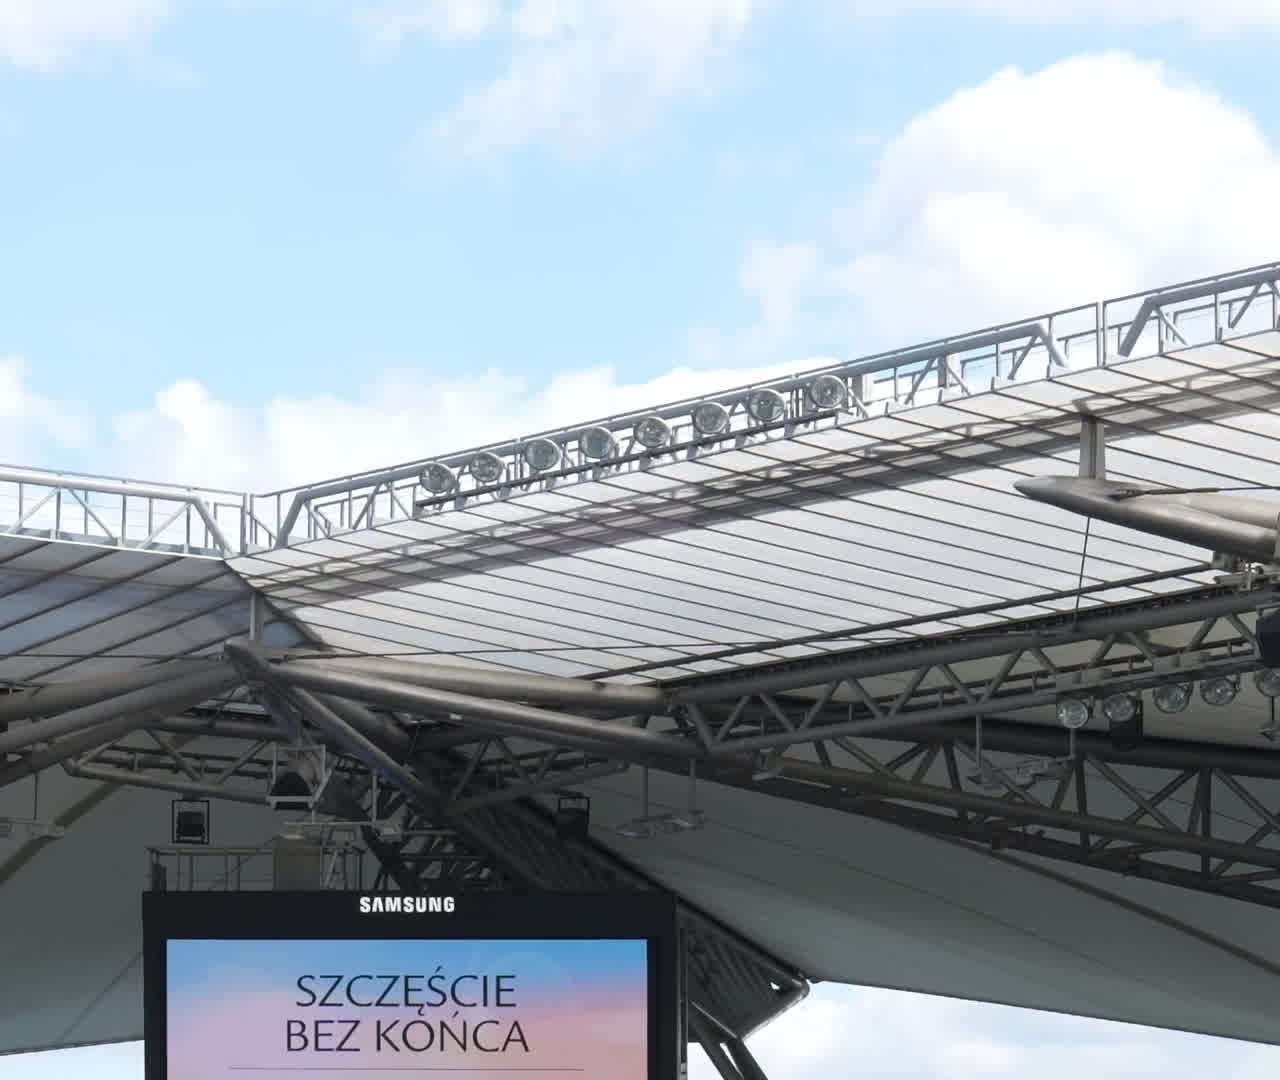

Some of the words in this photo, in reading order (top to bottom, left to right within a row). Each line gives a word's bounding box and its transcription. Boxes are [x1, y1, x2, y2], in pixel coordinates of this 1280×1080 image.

[359, 896, 455, 913] SAMSUNG
[295, 965, 518, 1017] SZCZĘŚCIE
[286, 1019, 361, 1052] BEZ
[375, 1010, 529, 1053] KOŃCA
